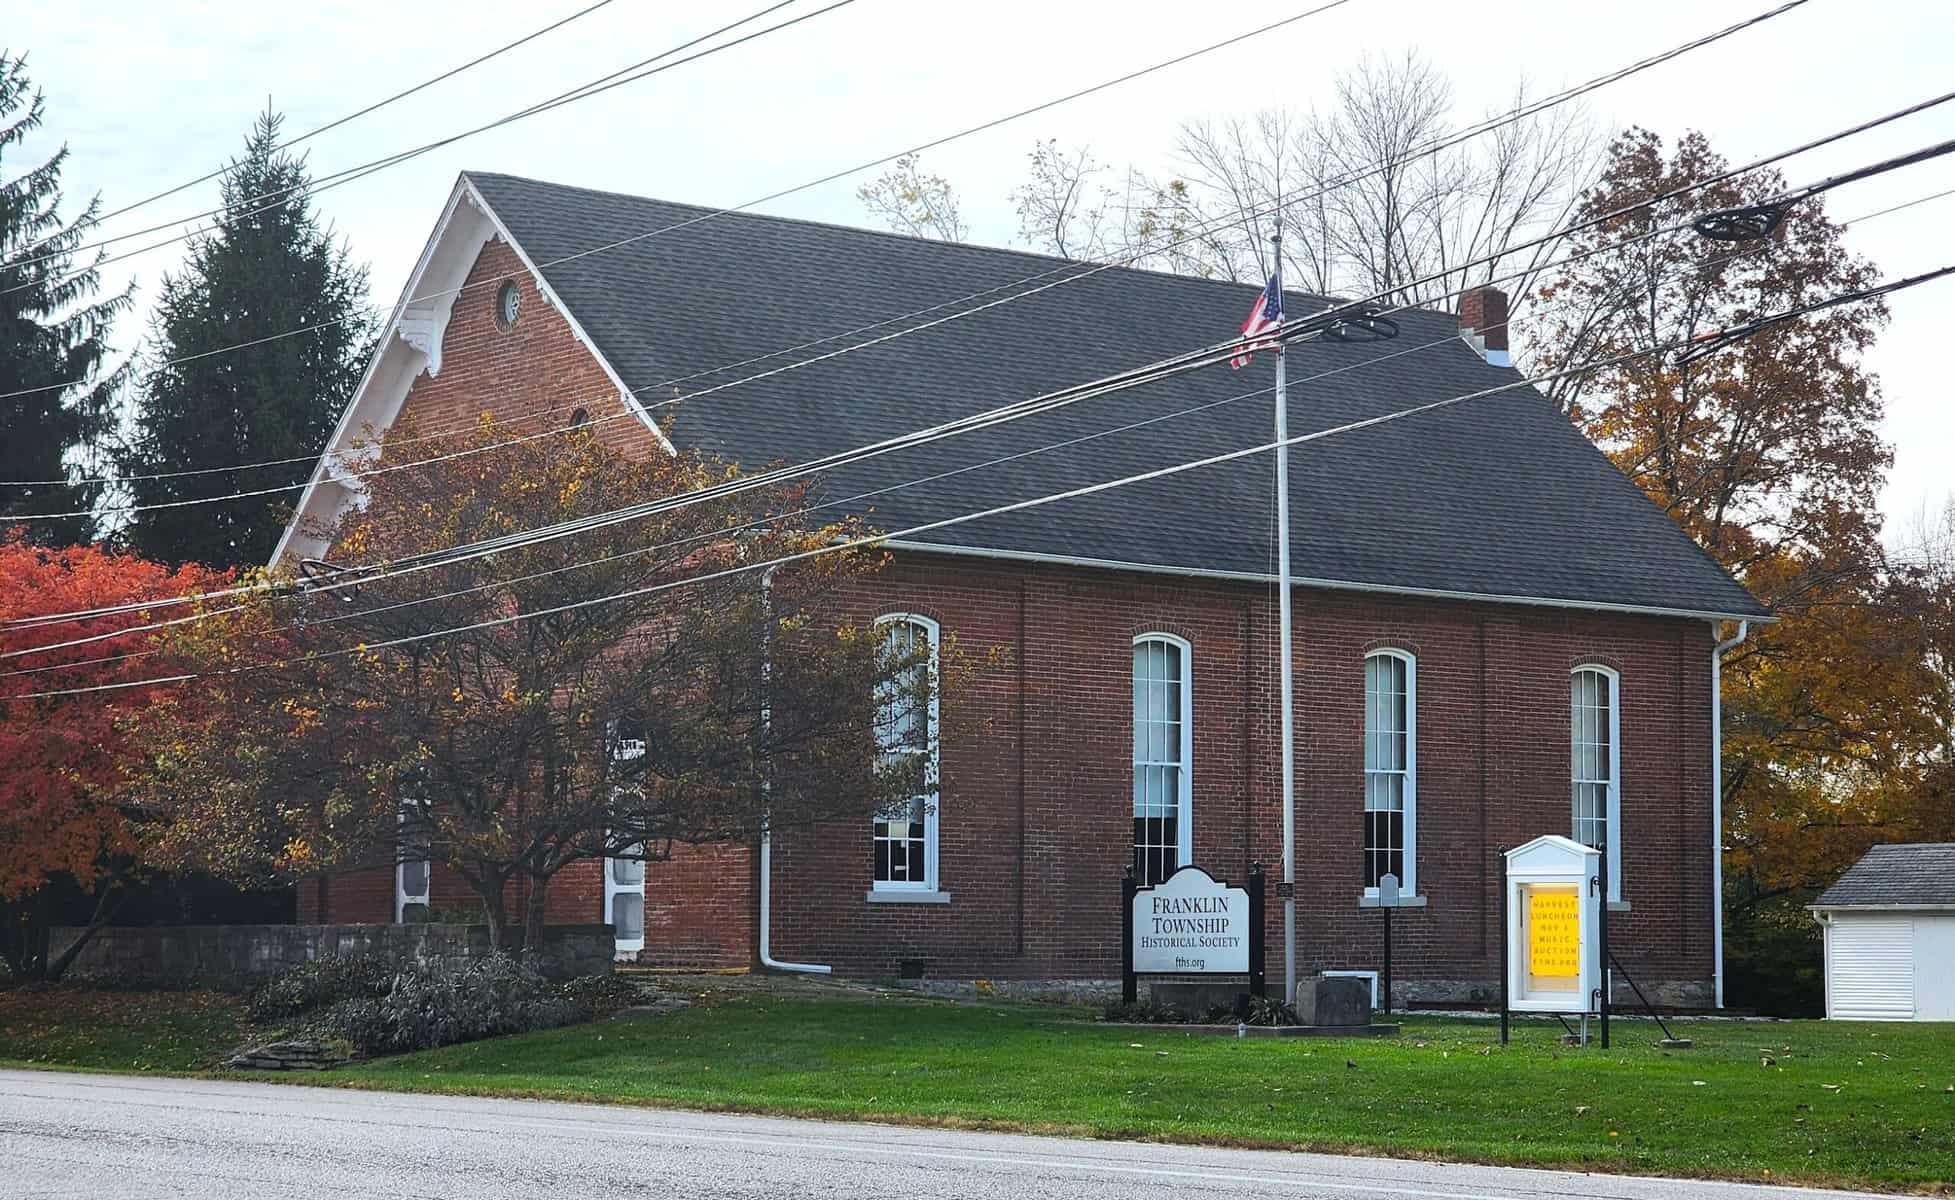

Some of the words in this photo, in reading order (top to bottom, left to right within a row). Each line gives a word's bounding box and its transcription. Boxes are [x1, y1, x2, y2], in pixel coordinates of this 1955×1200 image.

[1152, 896, 1230, 914] FRANKLIN
[1530, 912, 1579, 920] LUNCHEON
[1152, 917, 1230, 934] TOWNSHIP
[1141, 936, 1198, 948] HISTORICAL
[1199, 935, 1240, 948] SOCIETY
[1533, 947, 1577, 955] AUCTION
[1175, 956, 1205, 970] fths.org
